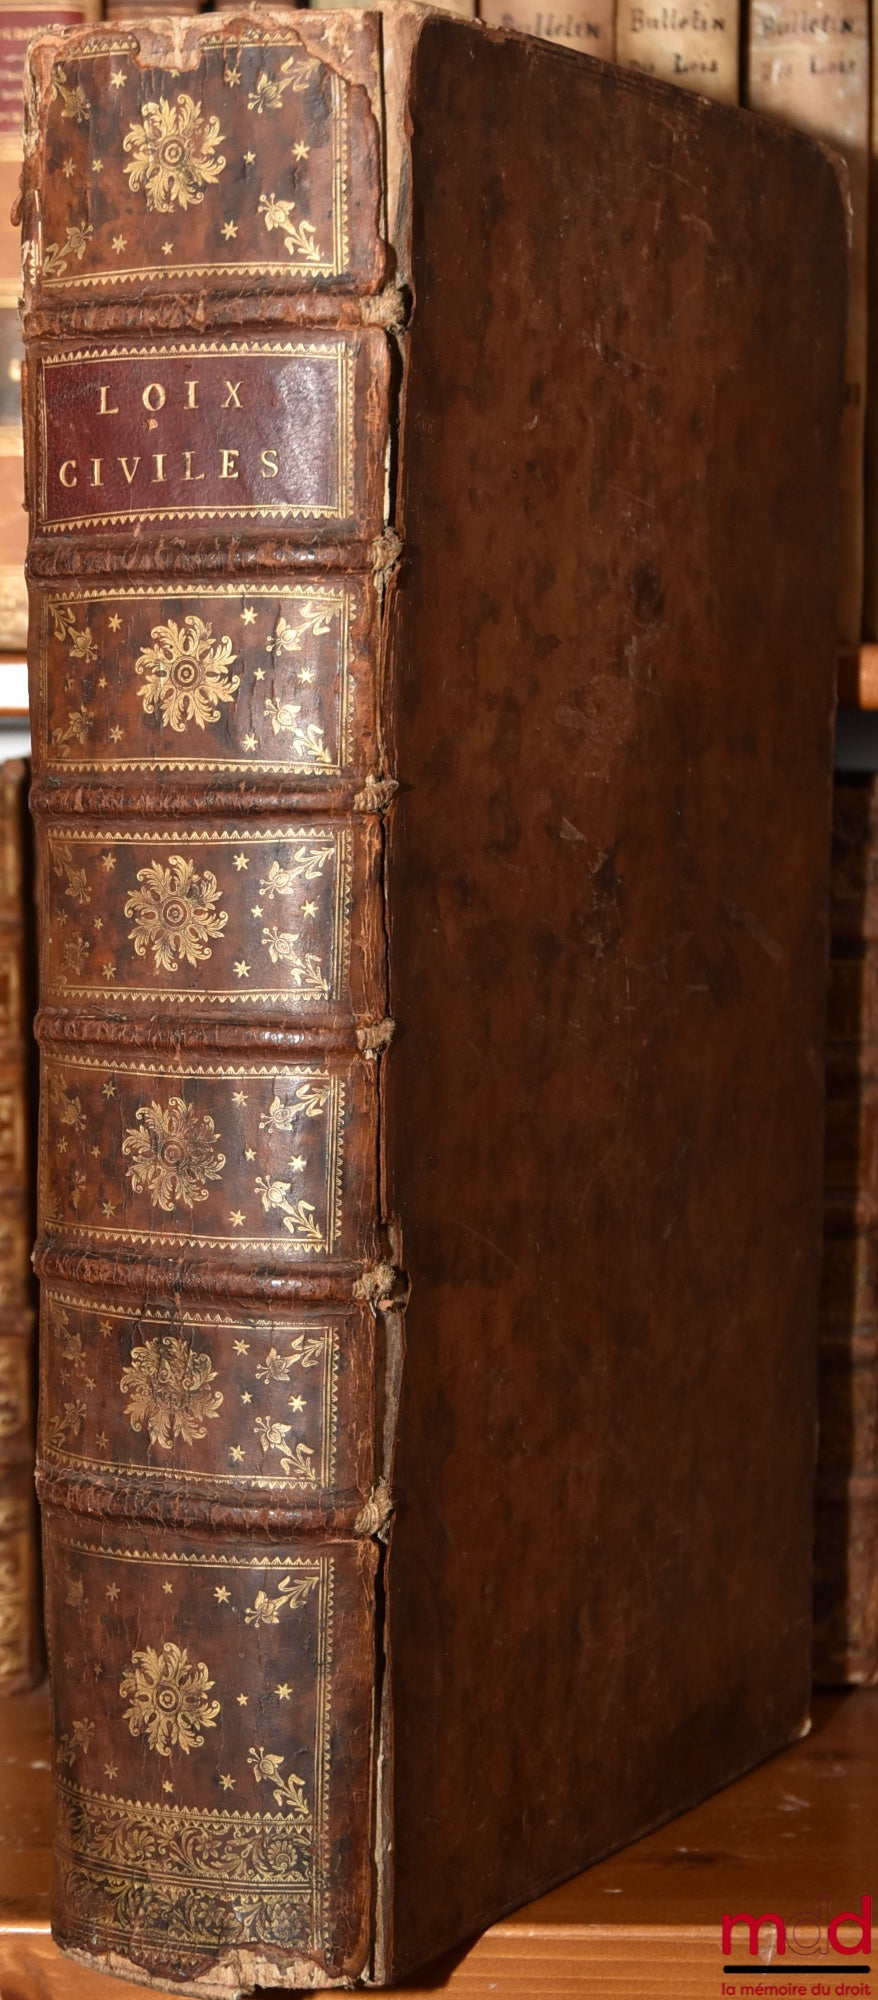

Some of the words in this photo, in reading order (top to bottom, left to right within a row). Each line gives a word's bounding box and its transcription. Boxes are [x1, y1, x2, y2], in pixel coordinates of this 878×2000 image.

[630, 7, 726, 33] Bulletin
[97, 379, 245, 415] LOIX
[58, 449, 281, 488] CIVILES
